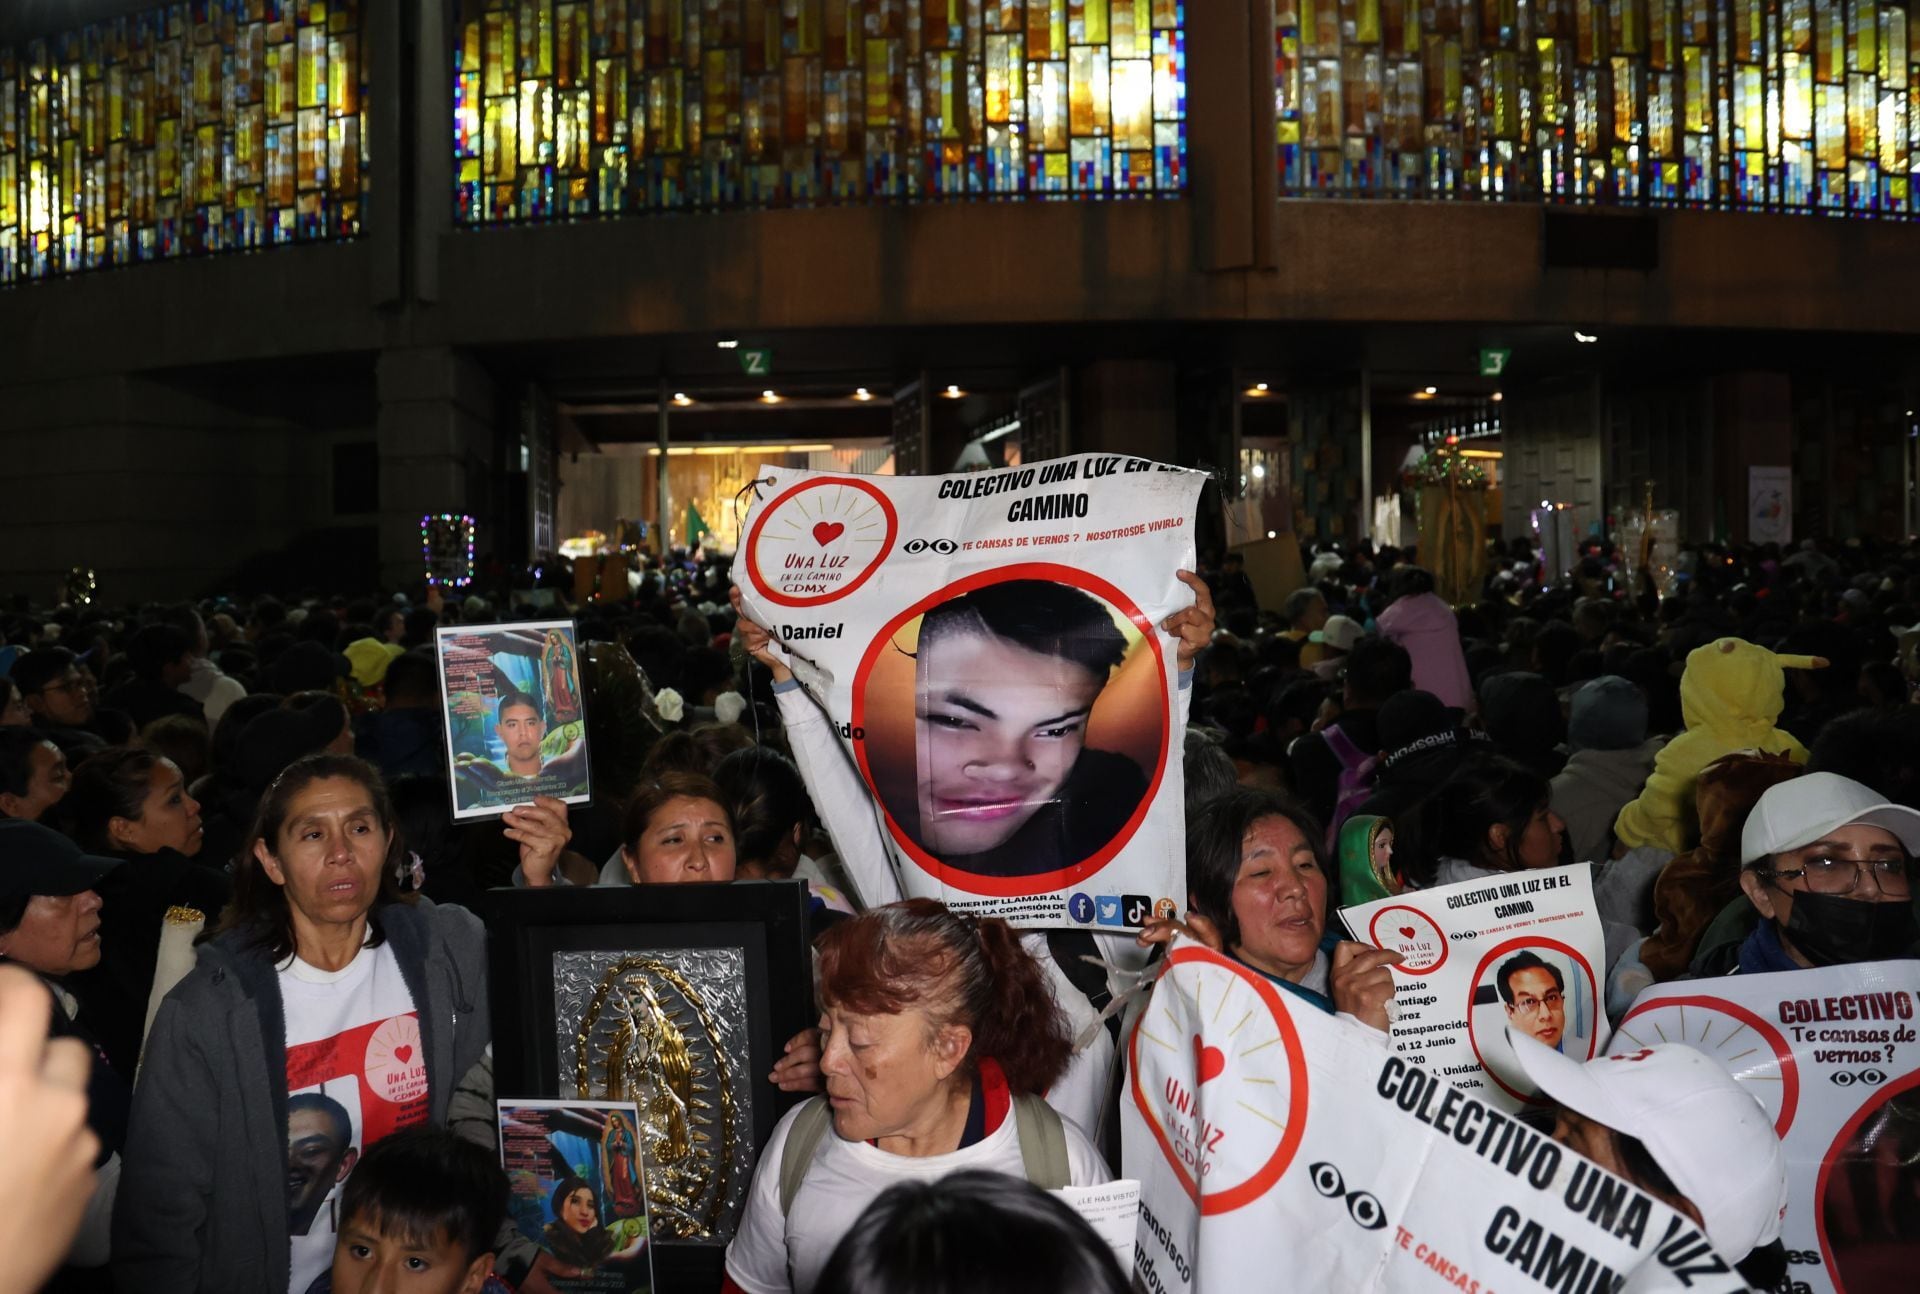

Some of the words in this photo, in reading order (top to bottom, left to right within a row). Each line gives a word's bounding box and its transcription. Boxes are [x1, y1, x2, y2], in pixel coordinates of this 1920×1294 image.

[1485, 352, 1504, 374] 3
[938, 468, 1035, 499] COLECTIVO
[1038, 460, 1078, 485] UNA
[1083, 457, 1123, 479] LUZ
[1007, 493, 1089, 522] CAMINO
[962, 542, 974, 551] TE
[975, 538, 1014, 549] CANSAS
[1016, 537, 1029, 546] DE
[1032, 534, 1069, 545] VERNOS
[1148, 517, 1184, 532] VIVIRLO
[784, 553, 815, 569] UNA
[820, 553, 850, 568] LUZ
[780, 573, 792, 581] EN
[794, 573, 803, 581] EL
[806, 571, 842, 581] CAMINO
[783, 584, 827, 593] CDMX
[782, 623, 844, 640] Daniel
[1001, 896, 1047, 905] LLAMAR
[1447, 890, 1499, 909] COLECTIVO
[1500, 885, 1521, 898] UNA
[1522, 881, 1541, 893] LUZ
[1543, 877, 1557, 890] EN
[1559, 875, 1571, 886] EL
[1494, 901, 1534, 919] CAMINO
[1486, 926, 1505, 934] CANSAS
[1399, 943, 1415, 952] UNA
[1416, 942, 1431, 951] LUZ
[1409, 959, 1432, 967] CDMX
[1396, 982, 1427, 992] nacio
[1397, 995, 1437, 1007] ntiago
[1779, 991, 1913, 1024] COLECTIVO
[1393, 1020, 1469, 1037] Desaparecido
[1790, 1026, 1817, 1042] Te
[1820, 1026, 1890, 1043] cansas
[1892, 1024, 1916, 1041] de
[1397, 1043, 1406, 1051] el
[1410, 1041, 1422, 1050] 12
[1425, 1037, 1456, 1047] Junio
[1814, 1048, 1881, 1063] vernos
[1884, 1044, 1896, 1063] ?
[1444, 1063, 1482, 1076] Unidad
[394, 1089, 421, 1101] CDMX
[1376, 1056, 1562, 1191] COLECTIVO
[1563, 1160, 1653, 1250] UNA
[1095, 1195, 1111, 1203] HAS
[1138, 1199, 1191, 1283] rancisco
[1485, 1205, 1626, 1294] CAMIN
[1395, 1224, 1413, 1250] TE
[1415, 1243, 1480, 1294] CANSAS
